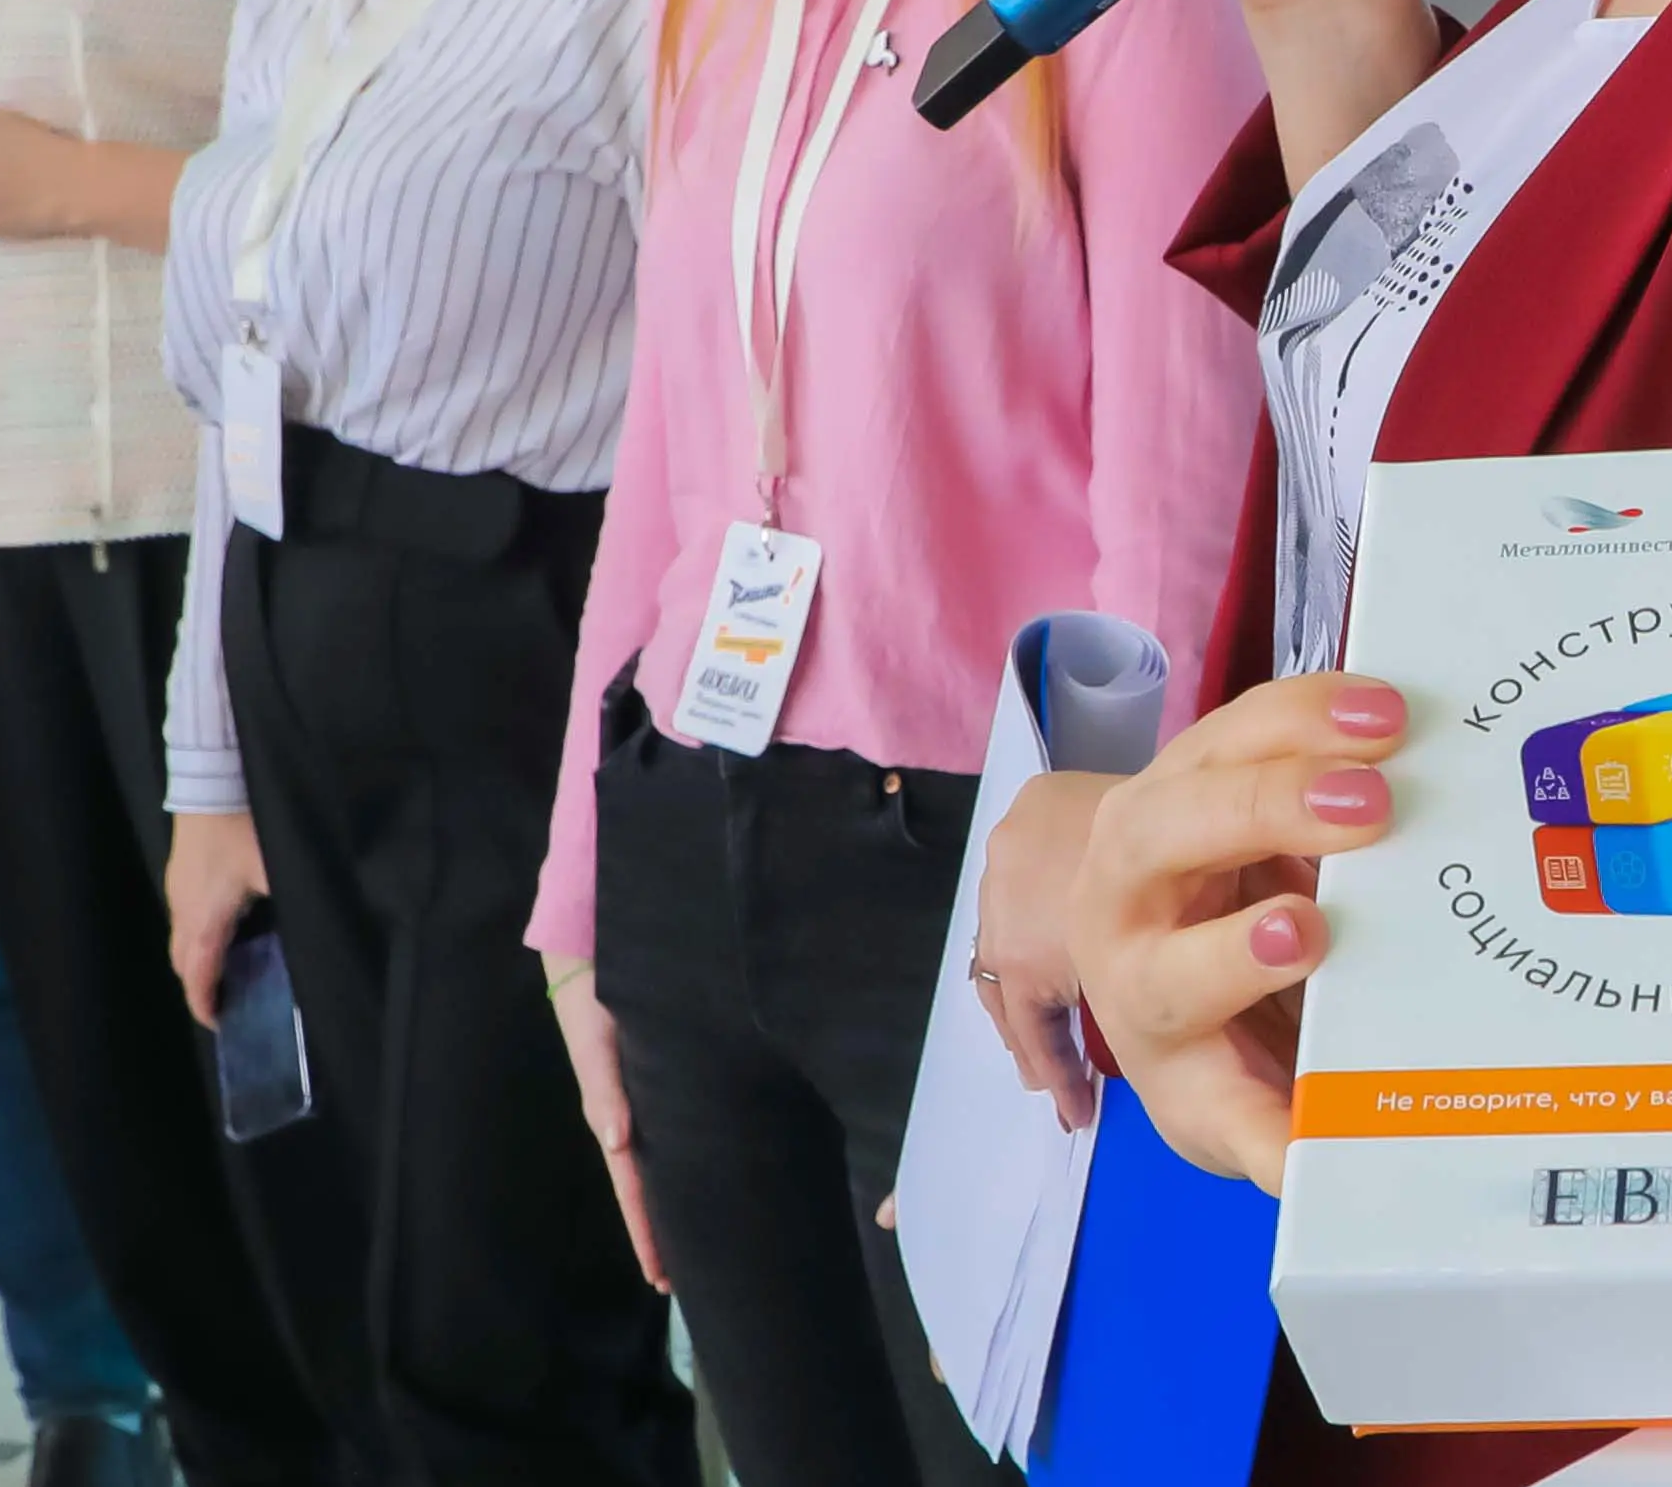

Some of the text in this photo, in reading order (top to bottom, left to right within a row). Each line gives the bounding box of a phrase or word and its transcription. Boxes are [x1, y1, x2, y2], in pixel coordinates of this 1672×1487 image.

[1376, 1092, 1414, 1111] Не
[1422, 1091, 1559, 1113] говорите,
[1569, 1090, 1616, 1107] что
[1624, 1090, 1640, 1111] у
